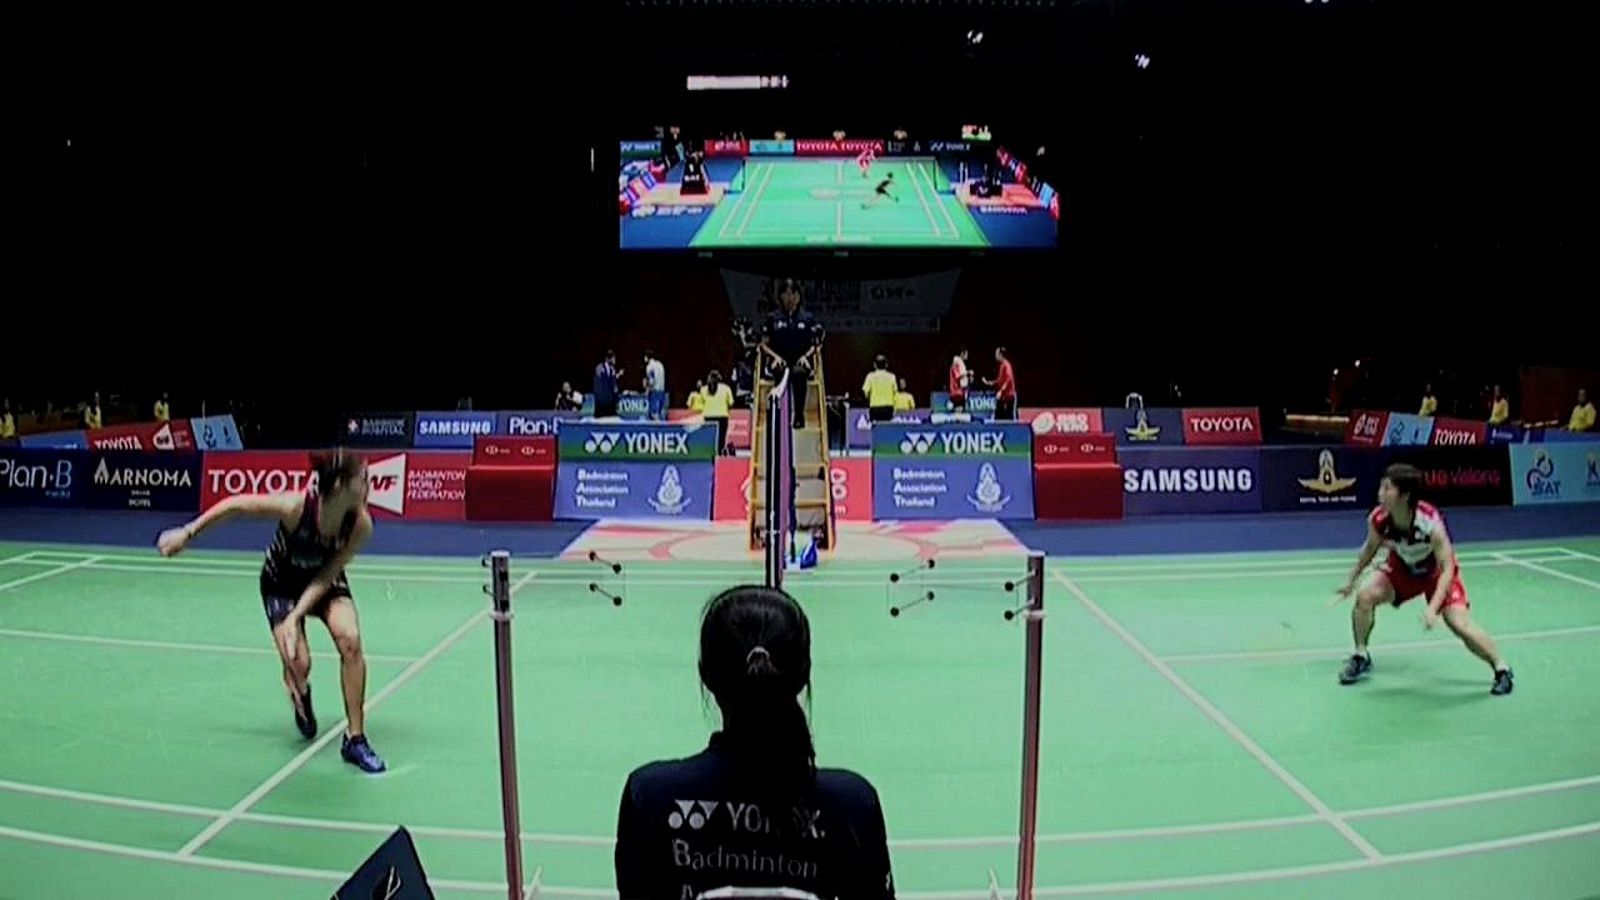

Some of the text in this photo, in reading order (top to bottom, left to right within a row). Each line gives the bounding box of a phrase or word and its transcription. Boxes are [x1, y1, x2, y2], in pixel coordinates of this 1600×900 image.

[419, 420, 492, 435] SAMSUNG
[1190, 417, 1253, 432] TOYOTA
[624, 432, 689, 454] YONEX
[940, 431, 1006, 454] YONEX
[1434, 429, 1477, 445] TOYOTA
[109, 468, 192, 488] ARNOMA
[408, 469, 466, 480] BADMINTON
[578, 469, 628, 481] Badminton
[893, 468, 946, 480] Badminton
[1123, 469, 1252, 492] SAMSUNG
[208, 469, 320, 499] TOYOTA
[408, 480, 442, 490] WORLD
[576, 482, 629, 494] Association
[893, 481, 947, 493] Association
[406, 489, 466, 500] FEDERATION
[576, 495, 616, 507] Thailand
[894, 494, 936, 507] Thailand
[671, 837, 818, 878] Badminton
